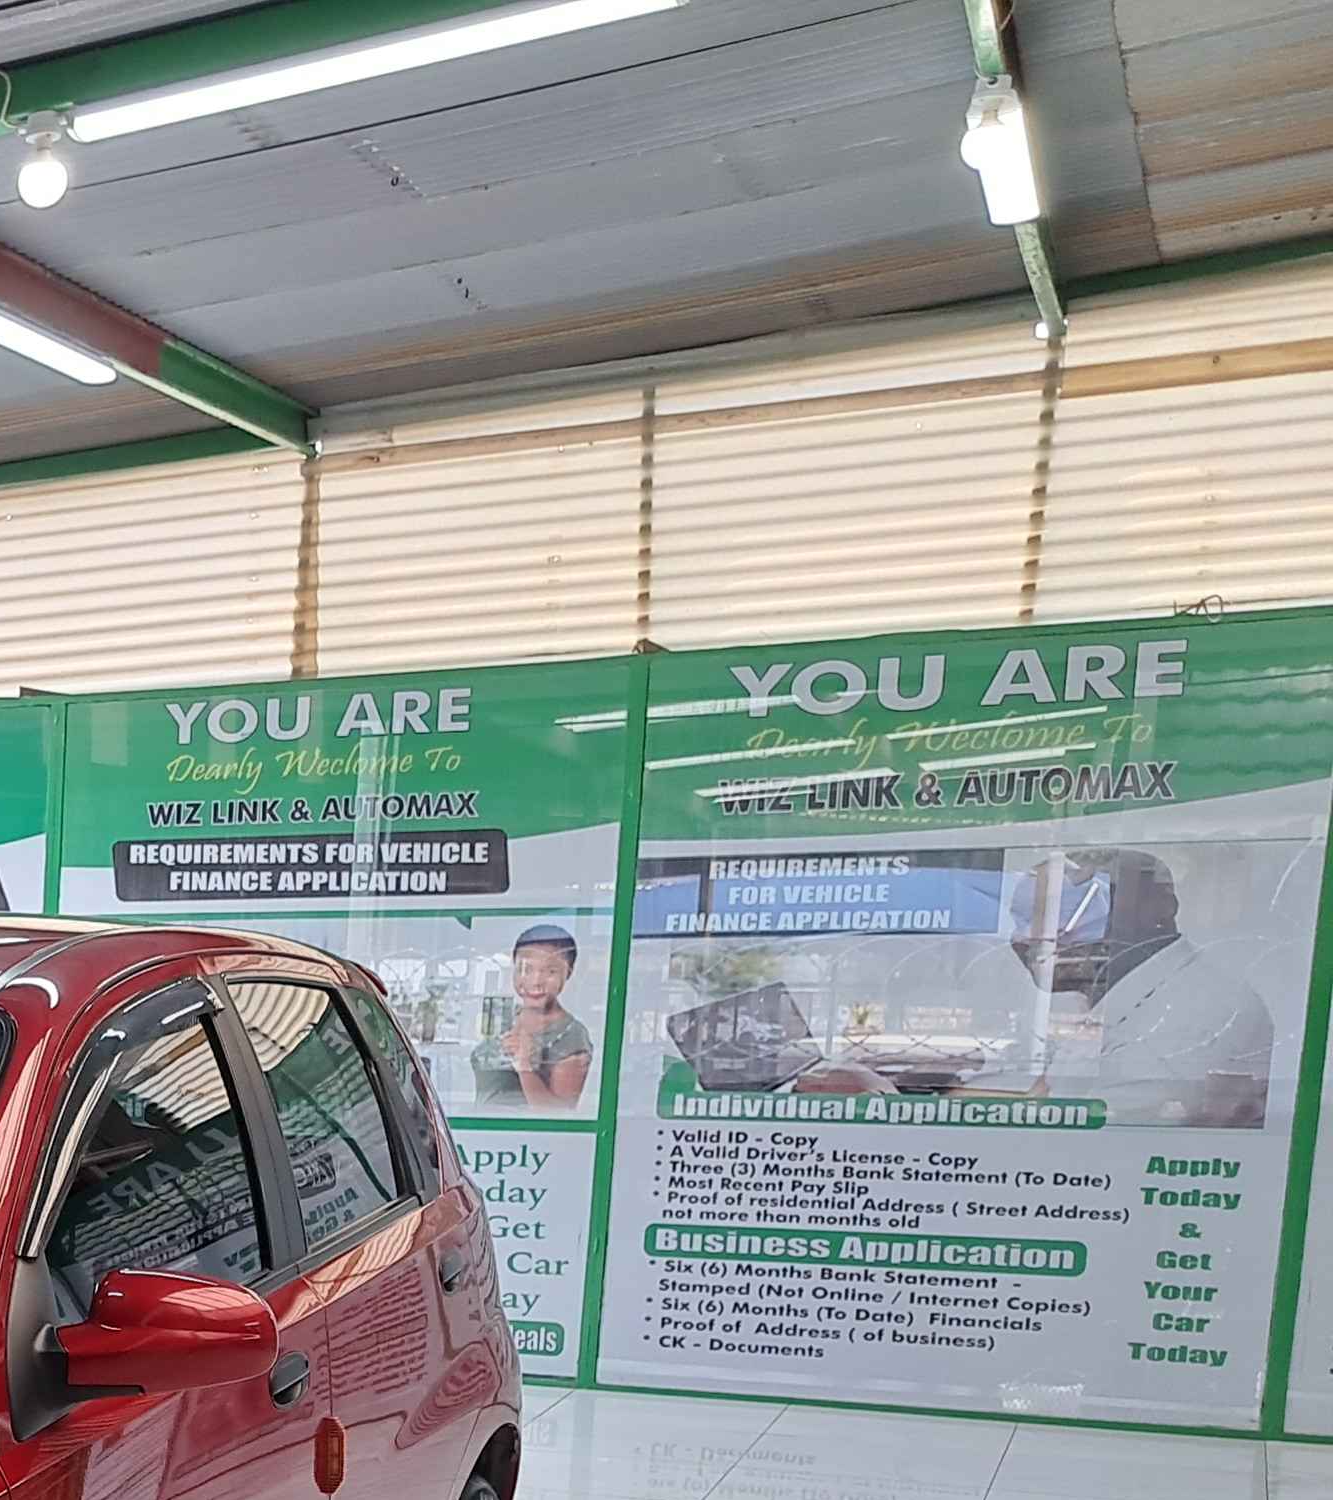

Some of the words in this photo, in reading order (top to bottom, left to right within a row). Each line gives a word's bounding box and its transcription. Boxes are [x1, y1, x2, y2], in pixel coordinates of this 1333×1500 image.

[730, 654, 947, 718] YOU
[980, 639, 1189, 707] ARE
[165, 695, 311, 745] YOU
[335, 687, 472, 737] ARE
[1102, 713, 1152, 745] To
[166, 747, 263, 794] Dearly
[275, 743, 413, 778] Weclome
[424, 745, 462, 772] To
[719, 778, 795, 814] WIZ
[806, 771, 904, 811] LINK
[913, 771, 943, 808] &
[952, 760, 1179, 807] AUTOMAX
[148, 801, 202, 827] WIZ
[211, 799, 283, 825] LINK
[290, 797, 312, 823] &
[320, 792, 480, 822] AUTOMAX
[129, 843, 319, 866] REQUIREMENTS
[324, 843, 378, 865] FOR
[381, 841, 489, 865] VEHICLE
[169, 871, 273, 892] FINANCE
[276, 870, 447, 892] APPLICATION
[708, 855, 910, 881] REQUIREMENTS
[728, 885, 776, 905] FOR
[783, 883, 890, 905] VEHICLE
[664, 911, 772, 933] FINANCE
[777, 909, 951, 931] APPLICATION
[673, 1092, 856, 1120] Individual
[864, 1096, 1089, 1126] Application
[672, 1129, 721, 1144] Valid
[728, 1131, 749, 1144] ID
[770, 1132, 819, 1150] Copy
[669, 1145, 684, 1159] A
[691, 1146, 739, 1160] Valid
[832, 1150, 905, 1165] License
[928, 1152, 979, 1171] Copy
[1145, 1155, 1241, 1178] Apply
[668, 1175, 714, 1191] Most
[720, 1177, 784, 1193] Recent
[791, 1180, 826, 1197] Pay
[832, 1181, 870, 1199] Slip
[669, 1160, 724, 1175] Three
[730, 1162, 756, 1178] (3)
[763, 1164, 835, 1179] Months
[842, 1166, 895, 1181] Bank
[902, 1167, 1008, 1184] Statement
[1014, 1171, 1045, 1188] (To
[1053, 1172, 1112, 1191] Date)
[484, 1179, 548, 1211] day
[666, 1191, 719, 1206] Proof
[724, 1192, 744, 1206] of
[749, 1195, 855, 1211] residential
[862, 1198, 945, 1215] Address
[966, 1201, 1029, 1217] Street
[1034, 1204, 1130, 1224] Address)
[1140, 1187, 1242, 1210] Today
[661, 1207, 693, 1221] not
[699, 1210, 749, 1223] more
[755, 1210, 801, 1224] than
[807, 1212, 882, 1228] months
[888, 1214, 921, 1229] old
[1178, 1222, 1203, 1239] &
[654, 1228, 831, 1258] Business
[838, 1235, 1075, 1270] Application
[1155, 1250, 1213, 1271] Get
[506, 1251, 570, 1277] Car
[664, 1259, 694, 1274] Six
[700, 1261, 728, 1278] (6)
[734, 1263, 813, 1280] Months
[820, 1267, 877, 1283] Bank
[883, 1270, 998, 1288] Statement
[659, 1278, 751, 1296] Stamped
[757, 1282, 804, 1299] (Not
[811, 1286, 885, 1304] Online
[909, 1291, 1000, 1310] Internet
[1006, 1296, 1091, 1317] Copies)
[1143, 1280, 1219, 1302] Your
[661, 1297, 691, 1312] Six
[697, 1299, 725, 1316] (6)
[731, 1301, 810, 1318] Months
[816, 1305, 847, 1323] (To
[855, 1308, 914, 1327] Date)
[929, 1312, 1044, 1332] Financials
[1152, 1312, 1211, 1333] Car
[659, 1335, 686, 1349] CK
[709, 1338, 825, 1358] Documents
[660, 1316, 716, 1332] Proof
[721, 1319, 743, 1334] of
[754, 1322, 841, 1340] Address
[863, 1328, 885, 1342] of
[891, 1329, 995, 1352] business)
[1127, 1342, 1229, 1367] Today
